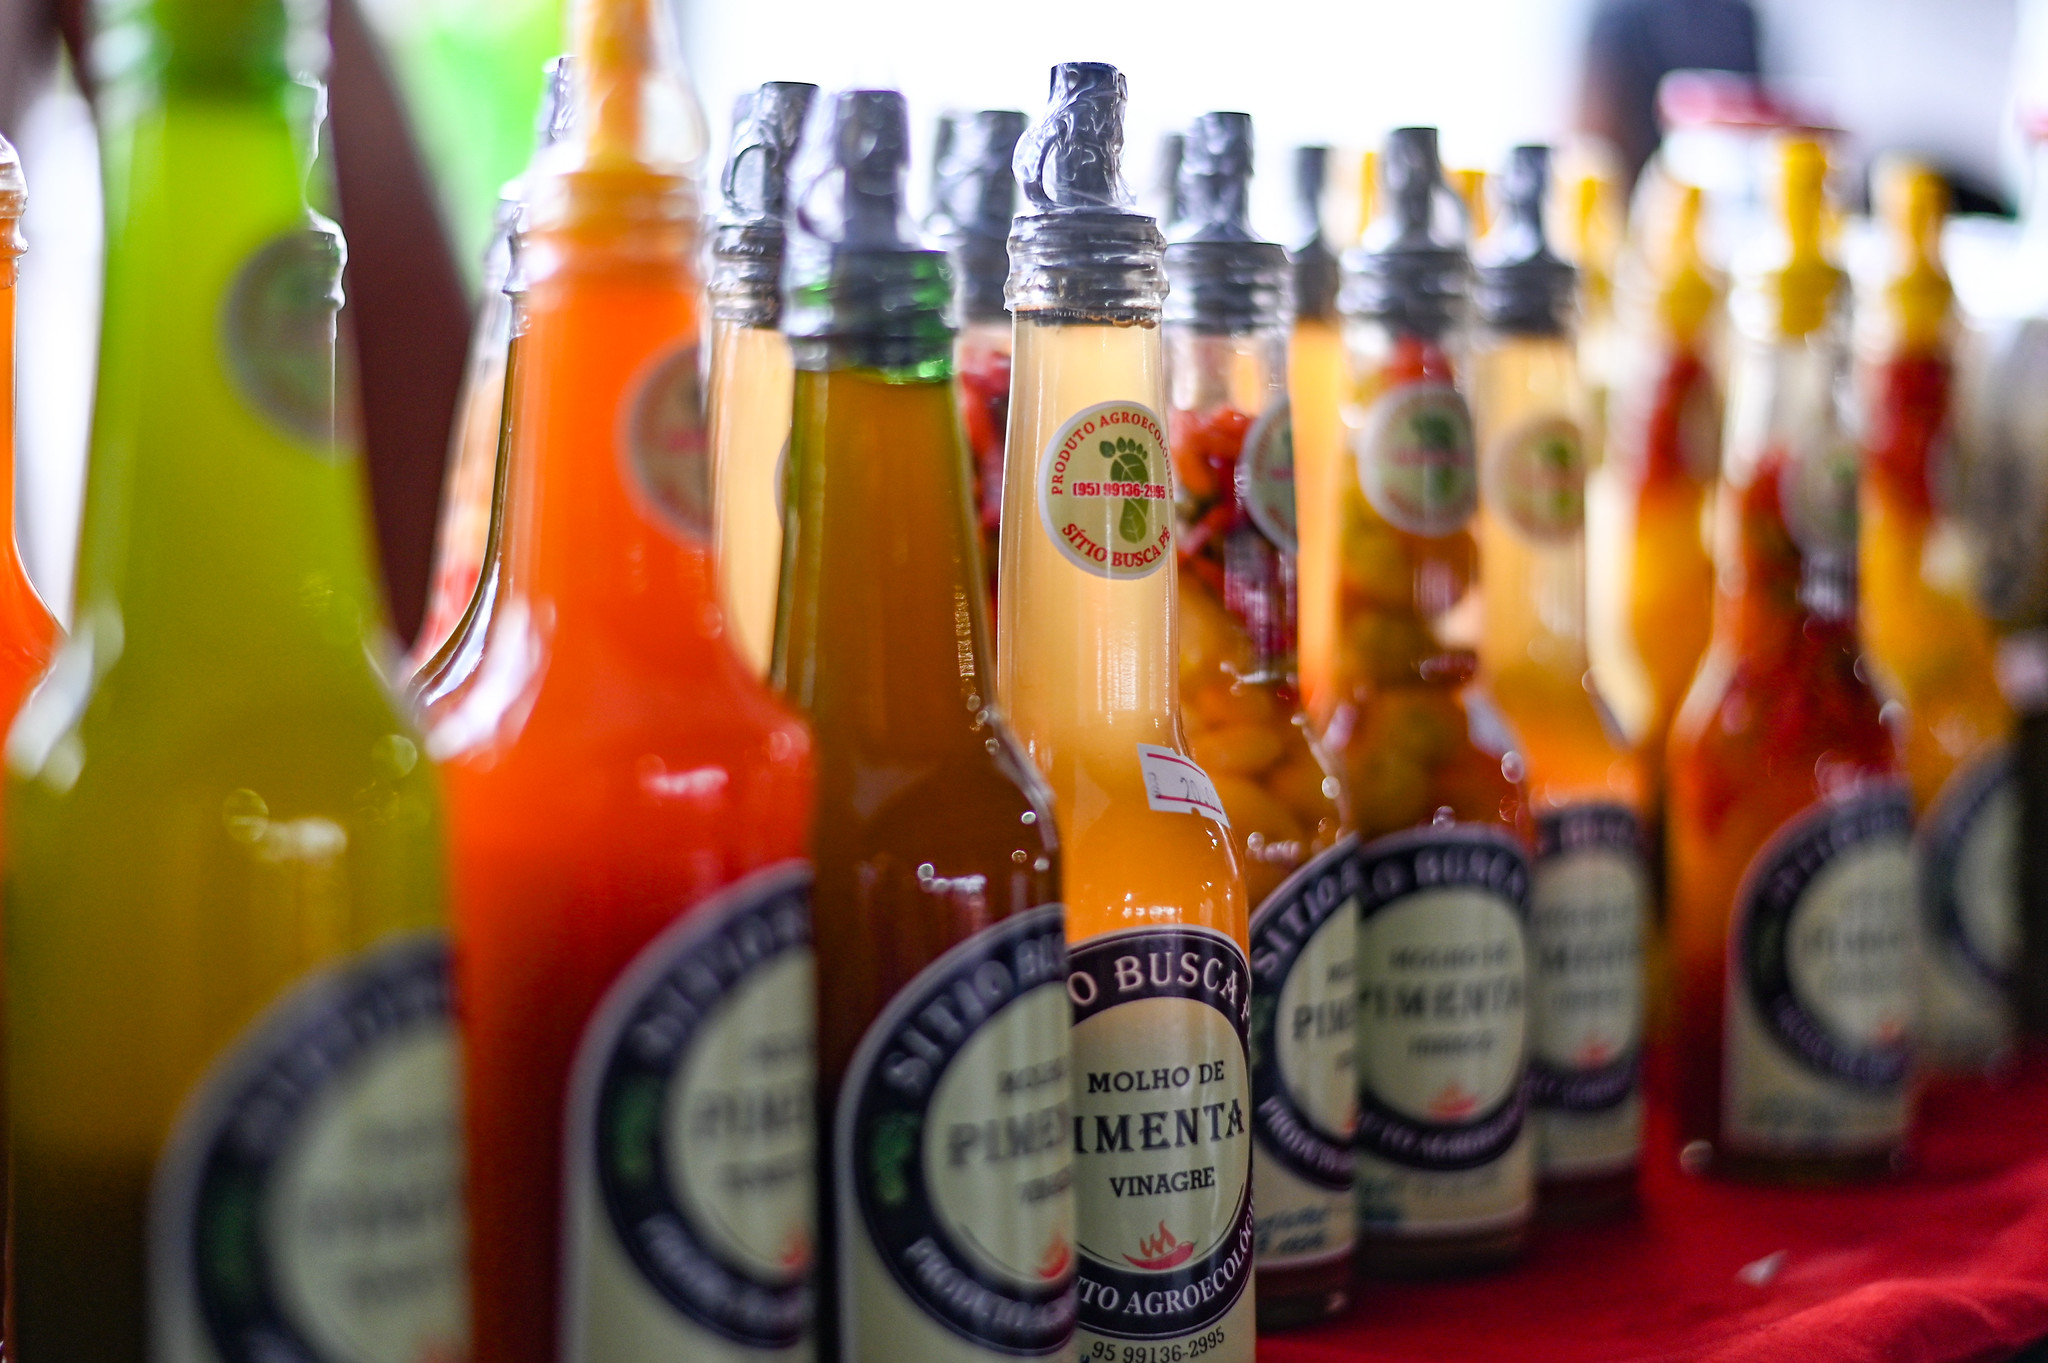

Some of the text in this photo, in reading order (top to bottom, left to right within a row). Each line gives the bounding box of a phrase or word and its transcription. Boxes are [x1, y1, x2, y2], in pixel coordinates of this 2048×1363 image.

[1052, 422, 1096, 496] PRODUTO
[1073, 482, 1166, 500] (95) 99136-2995
[1062, 522, 1108, 562] SÍTIO
[1111, 544, 1163, 568] BUSCA
[1113, 951, 1239, 1006] BUSCA
[1087, 1066, 1190, 1093] MOLHO
[1198, 1060, 1225, 1084] DE
[1072, 1098, 1245, 1154] IMENTA
[1109, 1166, 1216, 1198] VINAGRE
[1092, 1326, 1225, 1363] 95 99136-2995
